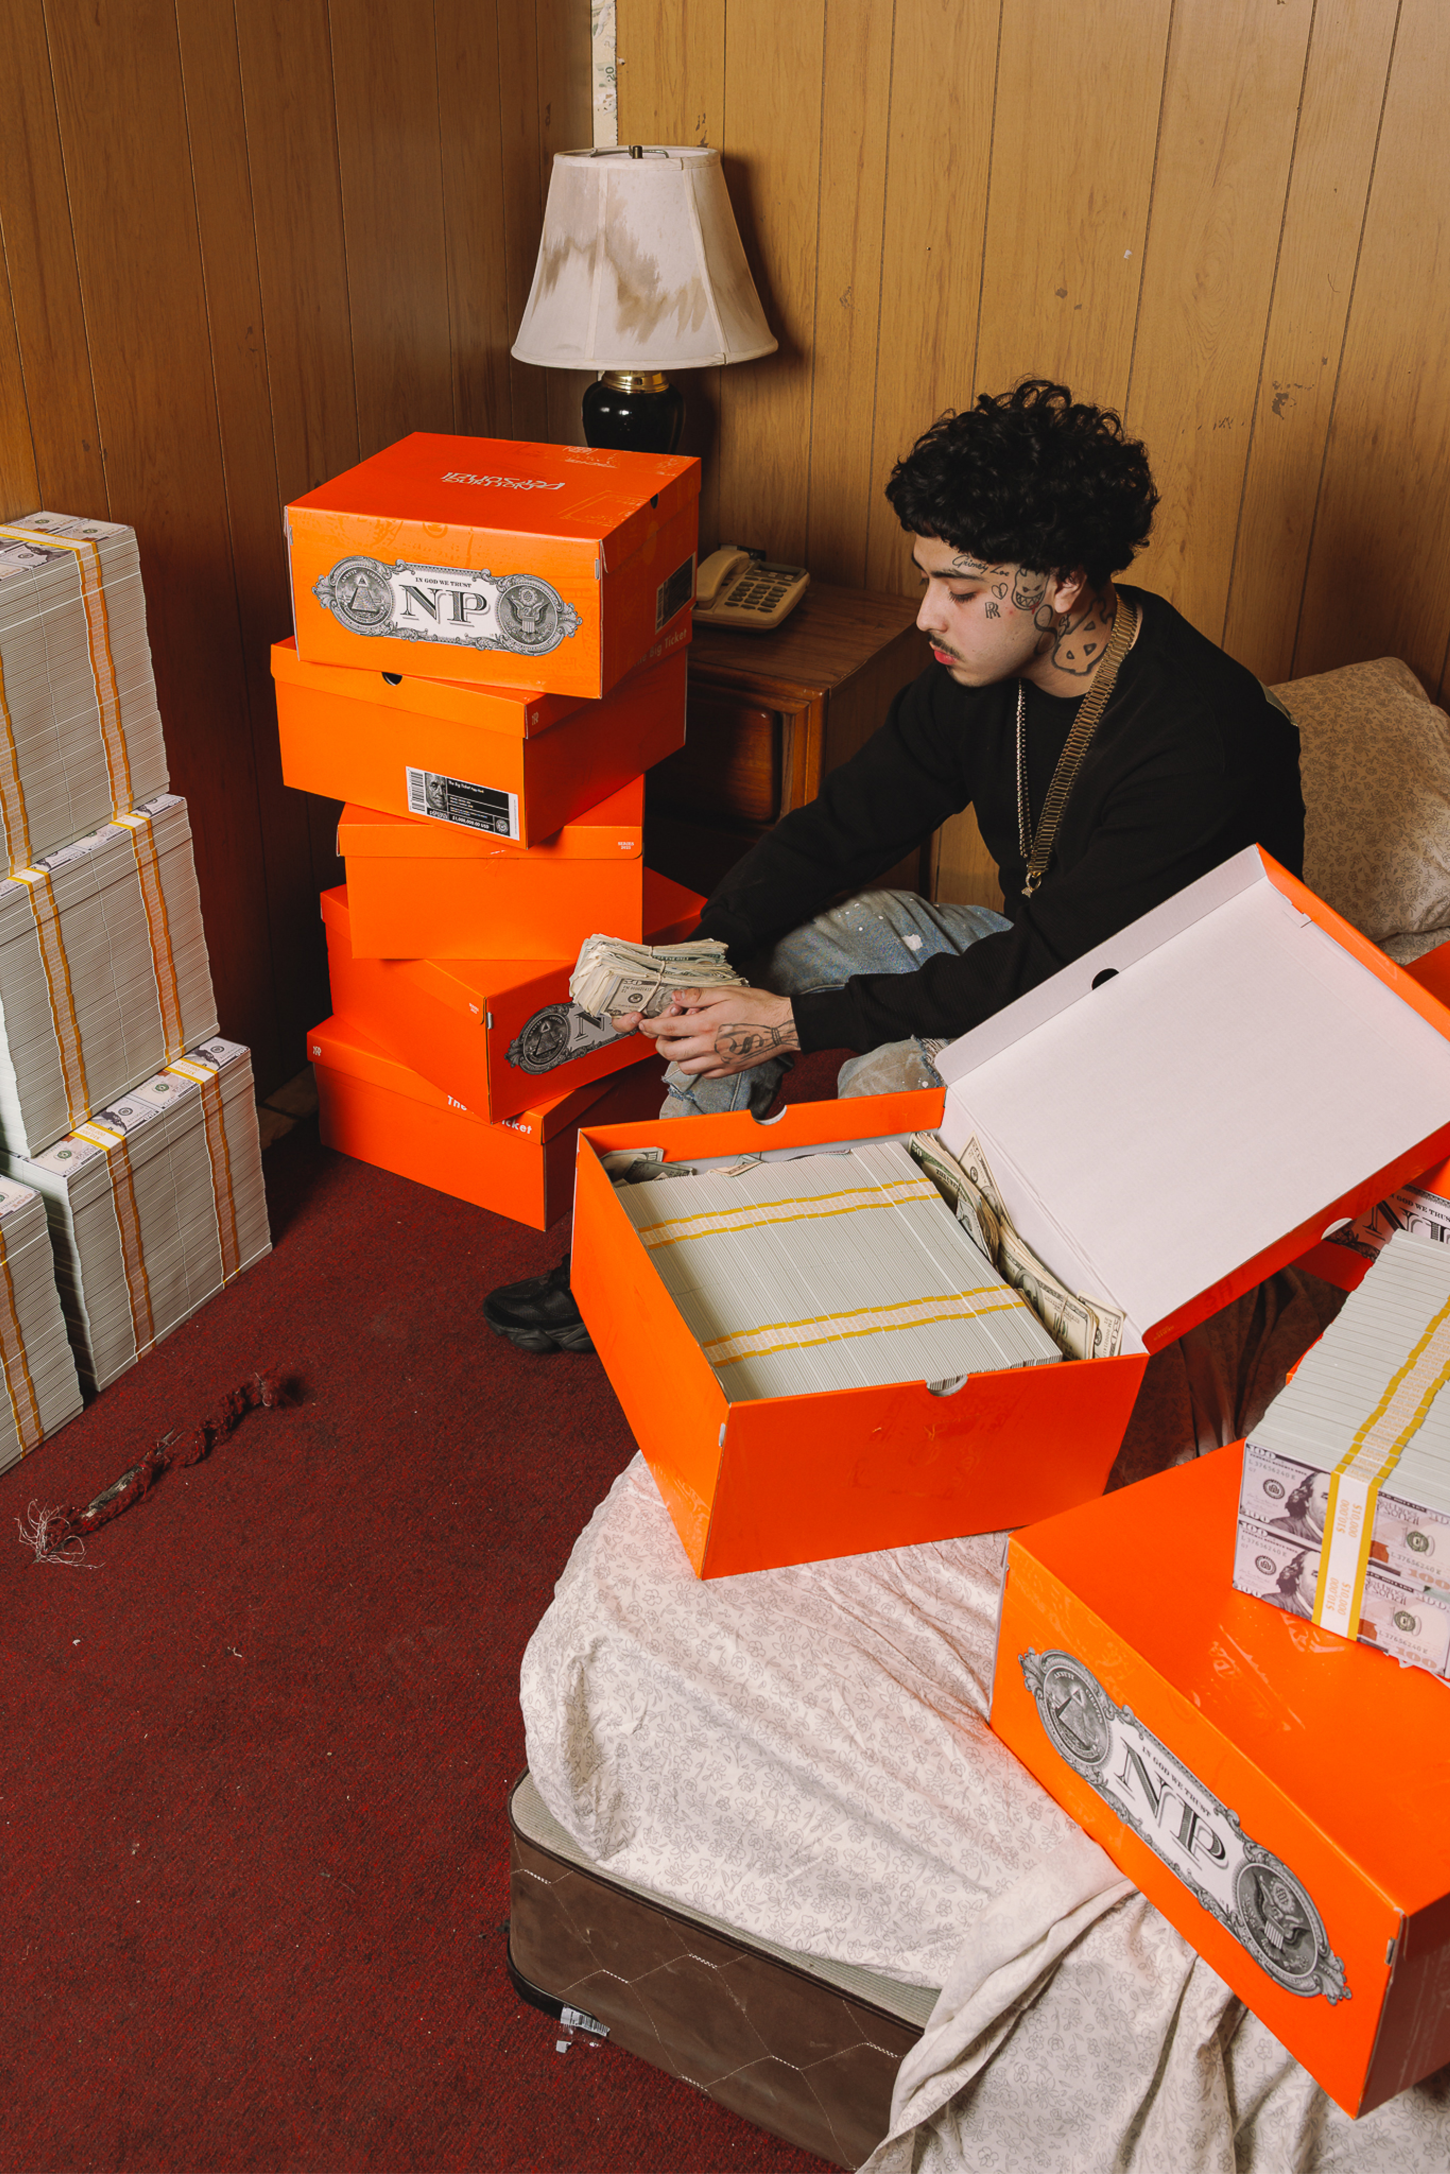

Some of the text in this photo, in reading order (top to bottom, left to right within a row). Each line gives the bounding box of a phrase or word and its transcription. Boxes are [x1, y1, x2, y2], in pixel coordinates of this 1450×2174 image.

[440, 472, 566, 490] Personal
[398, 584, 488, 625] NP
[665, 628, 687, 650] Ticket
[573, 1010, 605, 1041] N
[502, 1119, 532, 1134] icket
[1396, 1195, 1414, 1206] GOD
[1415, 1202, 1428, 1213] WE
[1429, 1208, 1450, 1222] TRUS
[1248, 1445, 1276, 1460] 100
[1245, 1510, 1270, 1524] 100
[1336, 1499, 1350, 1534] $10,000
[1348, 1503, 1362, 1538] $10,000
[1428, 1512, 1450, 1525] 10
[1241, 1522, 1268, 1537] 100
[1408, 1568, 1450, 1590] 100
[1237, 1584, 1262, 1598] 100
[1326, 1577, 1340, 1611] $10,000
[1337, 1582, 1352, 1616] $10,000
[1395, 1647, 1437, 1669] 100
[1142, 1746, 1211, 1817] IN GOD WE TRUST
[1114, 1736, 1228, 1870] NP
